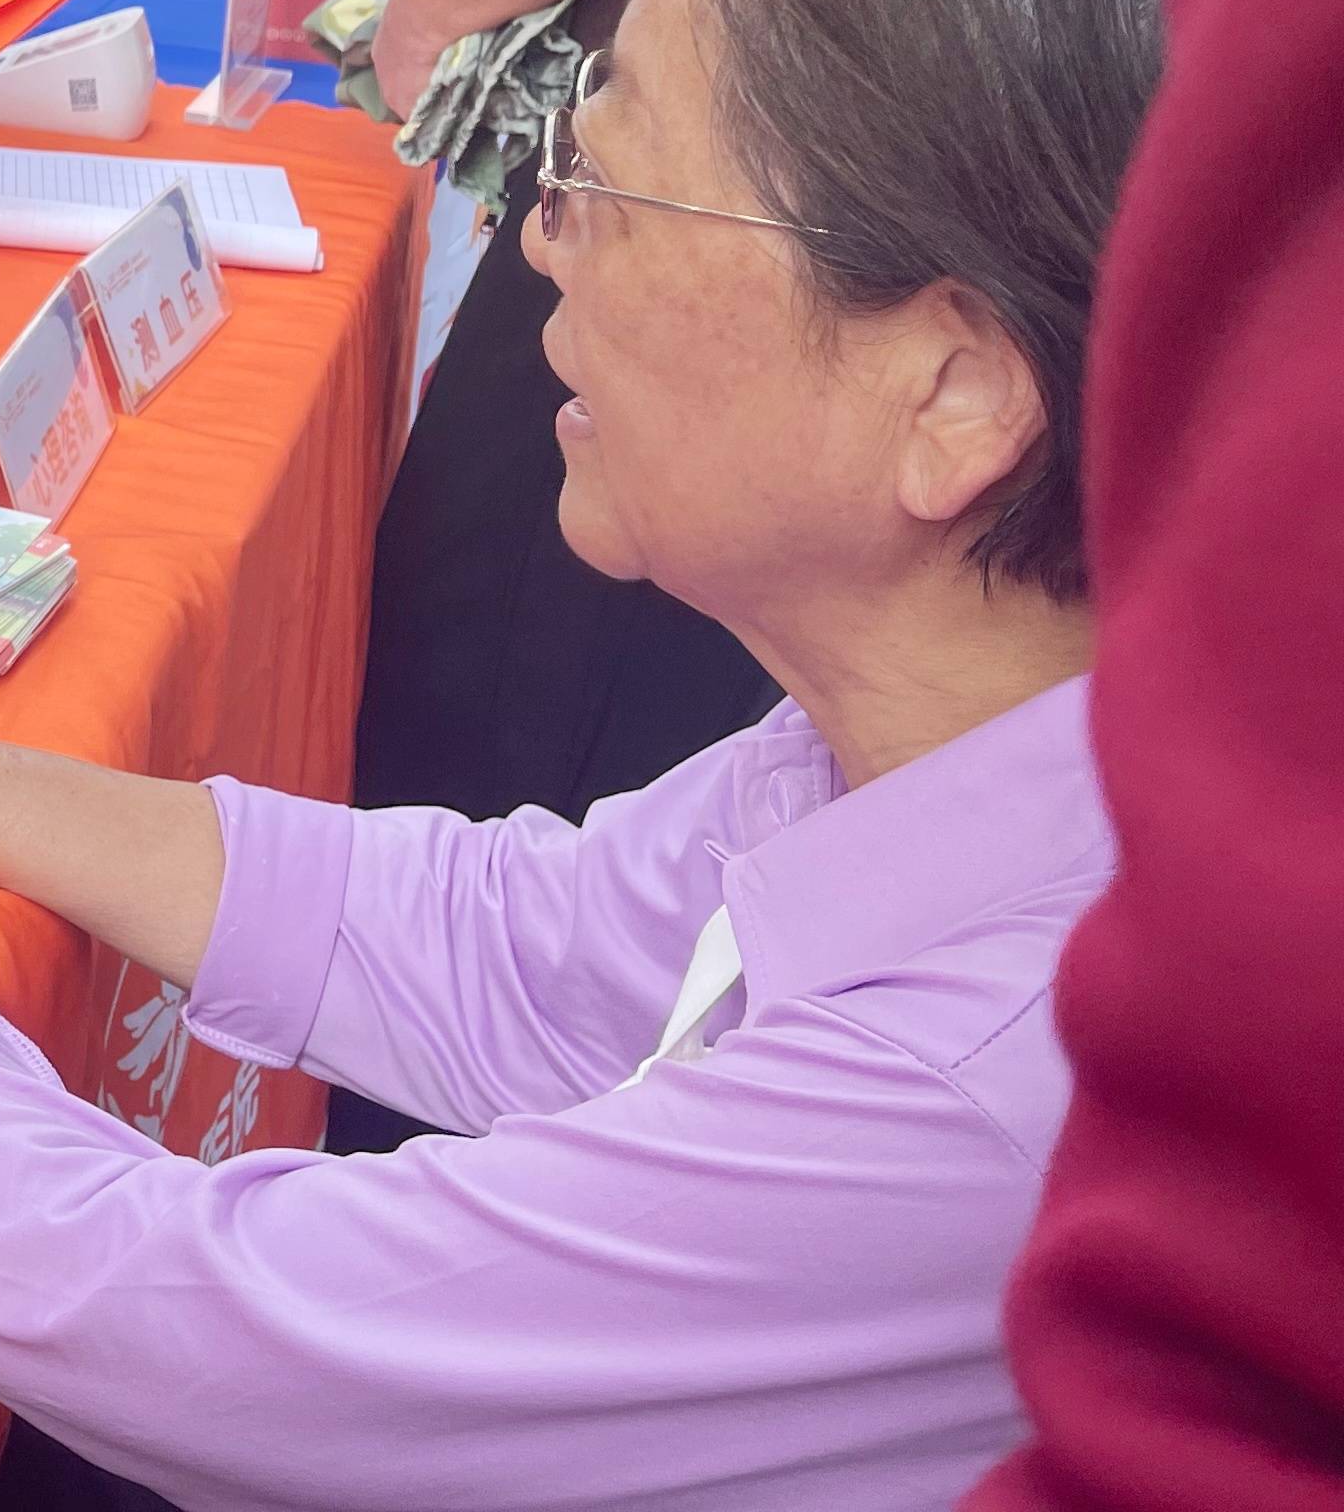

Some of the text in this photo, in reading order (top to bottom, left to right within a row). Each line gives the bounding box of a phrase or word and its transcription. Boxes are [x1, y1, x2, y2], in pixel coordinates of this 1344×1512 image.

[130, 269, 204, 372] 测血压
[29, 390, 95, 507] 心理咨询
